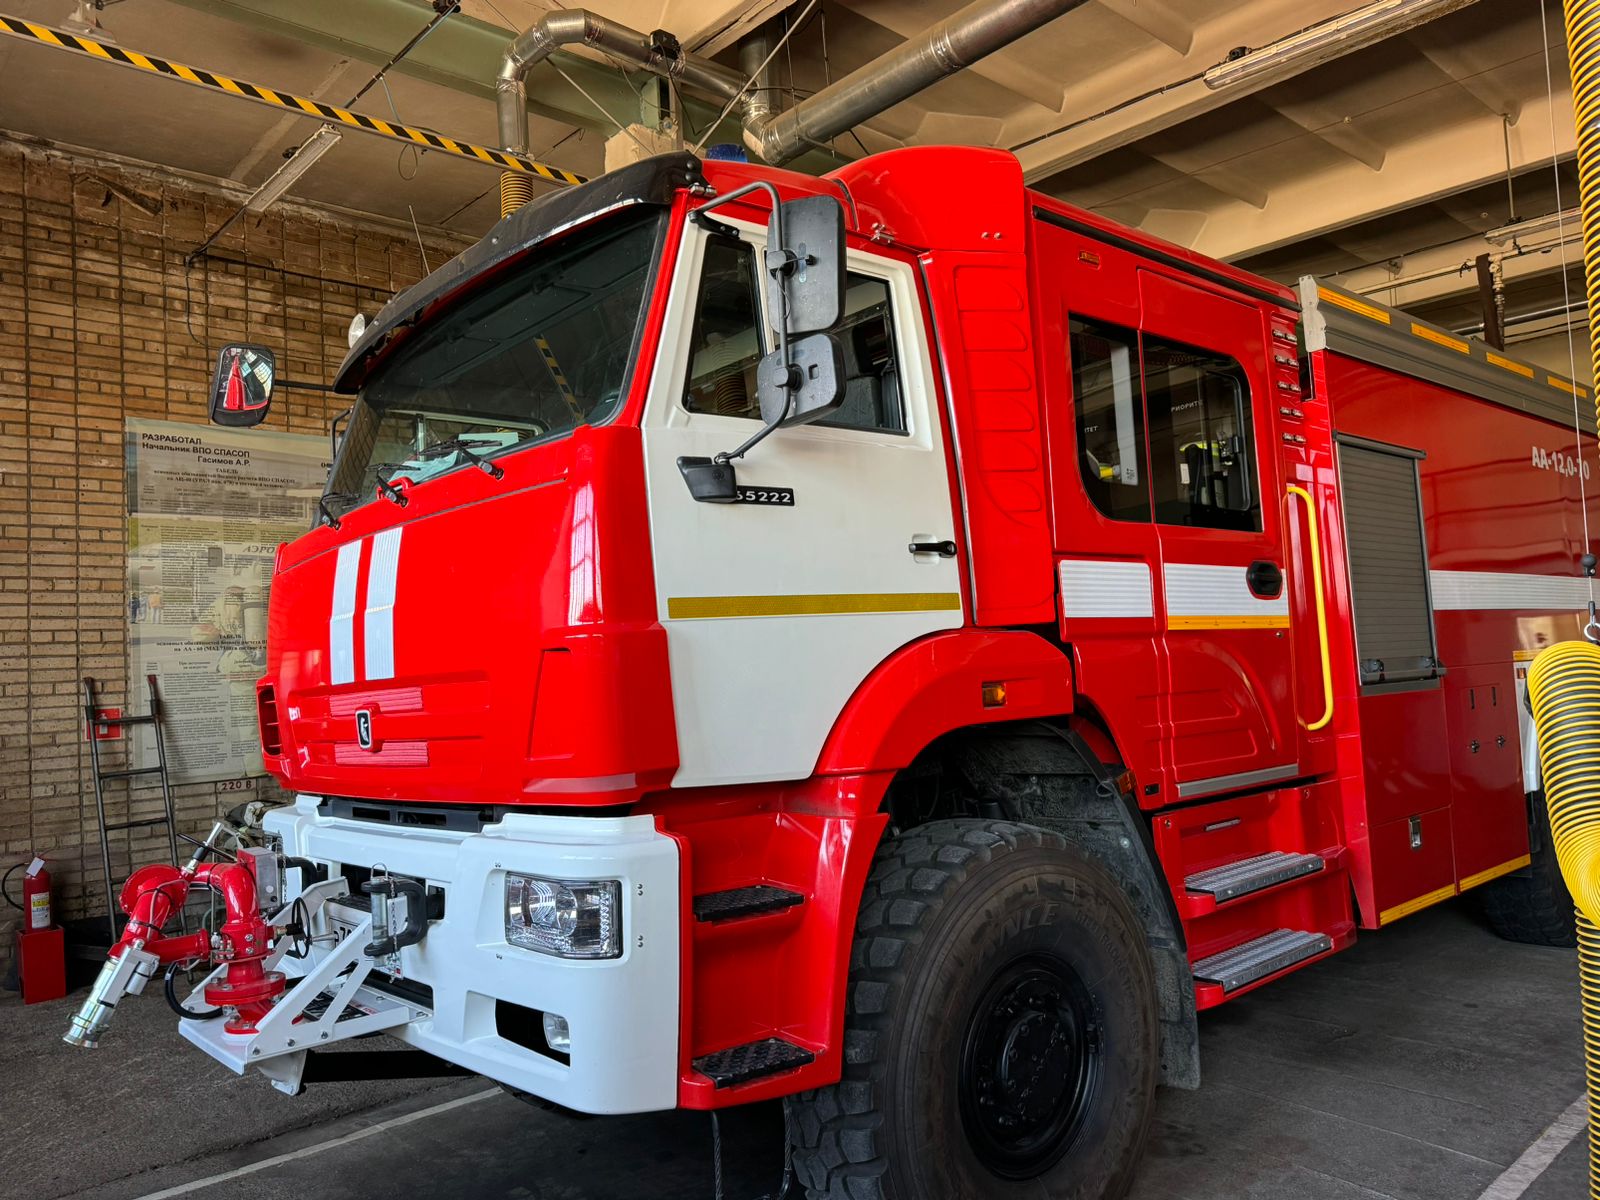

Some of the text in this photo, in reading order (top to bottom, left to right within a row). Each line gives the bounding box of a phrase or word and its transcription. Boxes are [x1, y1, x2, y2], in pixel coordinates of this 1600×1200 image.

[142, 432, 202, 445] РАЗРАБОТАЛ
[142, 442, 250, 458] Начальник ВПО СПАСОП
[197, 455, 234, 465] Гасимов
[222, 781, 242, 790] 220
